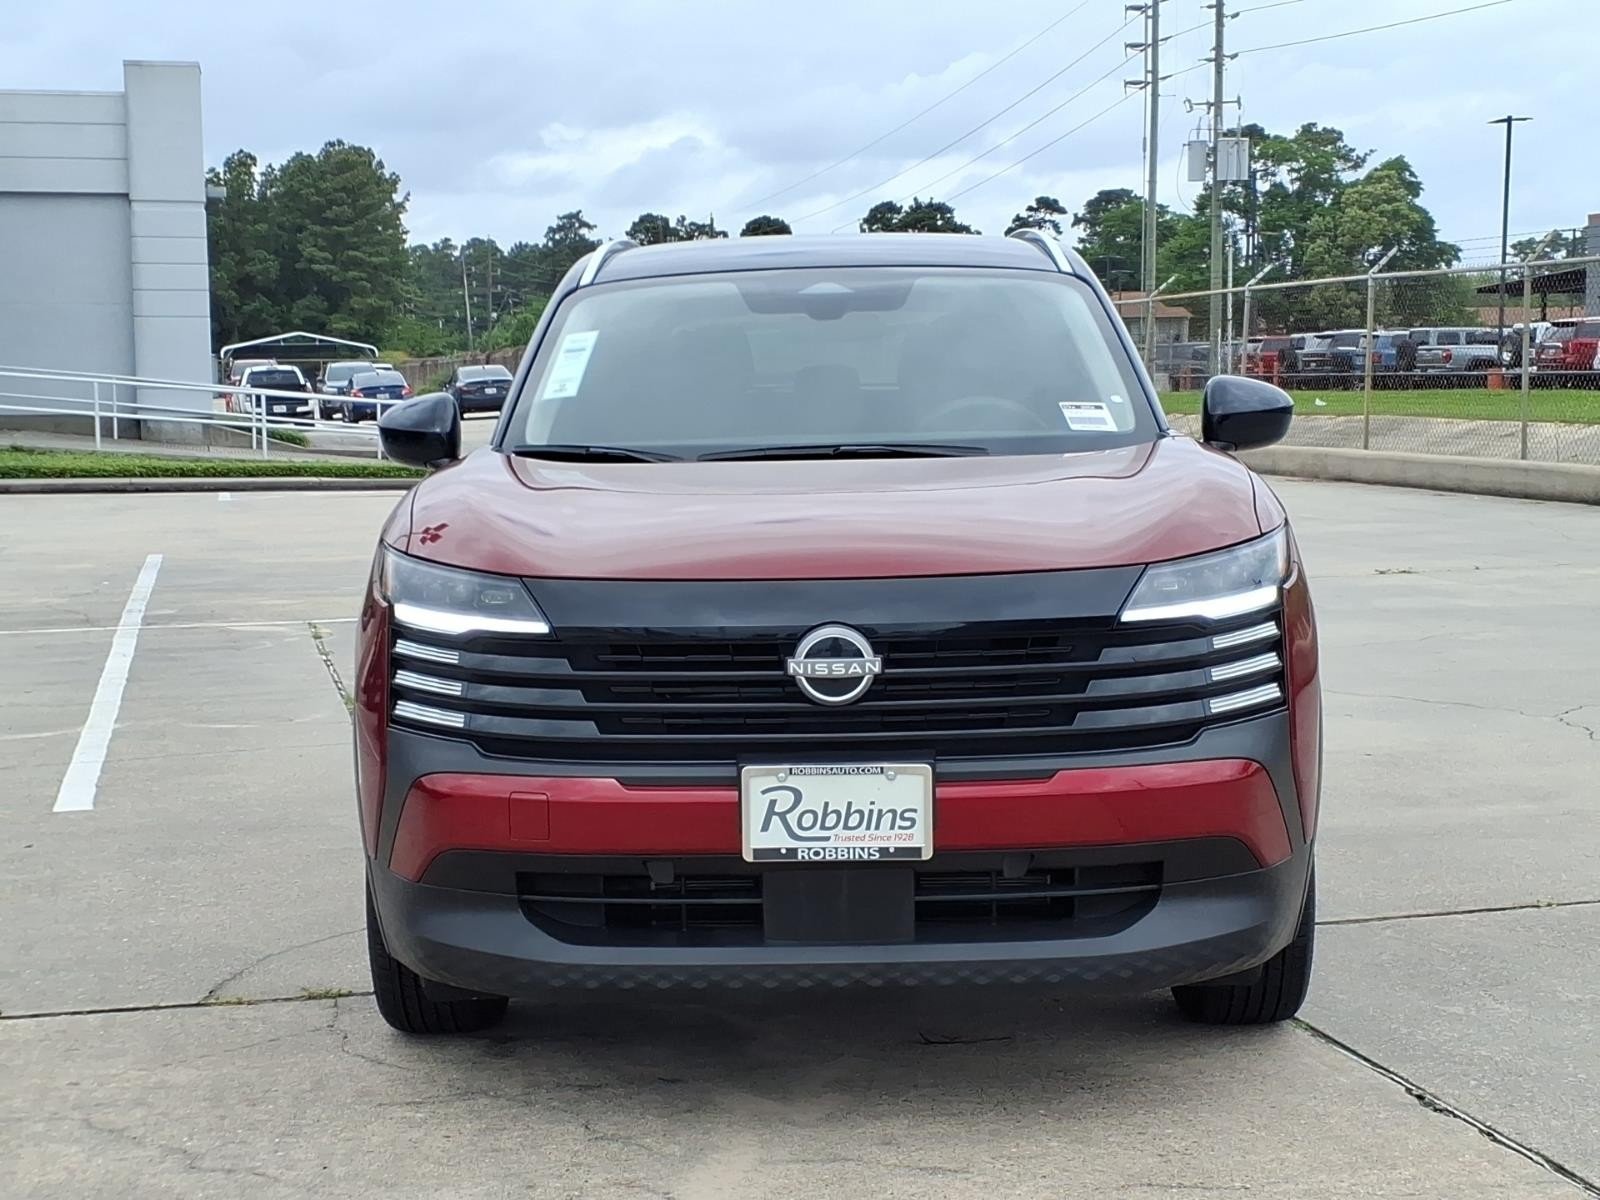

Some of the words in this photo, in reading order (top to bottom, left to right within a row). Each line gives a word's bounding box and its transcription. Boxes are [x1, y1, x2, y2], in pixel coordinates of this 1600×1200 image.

[789, 661, 880, 675] NISSAN
[791, 767, 882, 776] ROBBINSAUTO.COM
[760, 785, 918, 842] Robbins
[833, 833, 867, 842] Trusted
[867, 833, 892, 842] Since
[893, 832, 914, 842] 1928
[797, 847, 880, 860] ROBBINS
